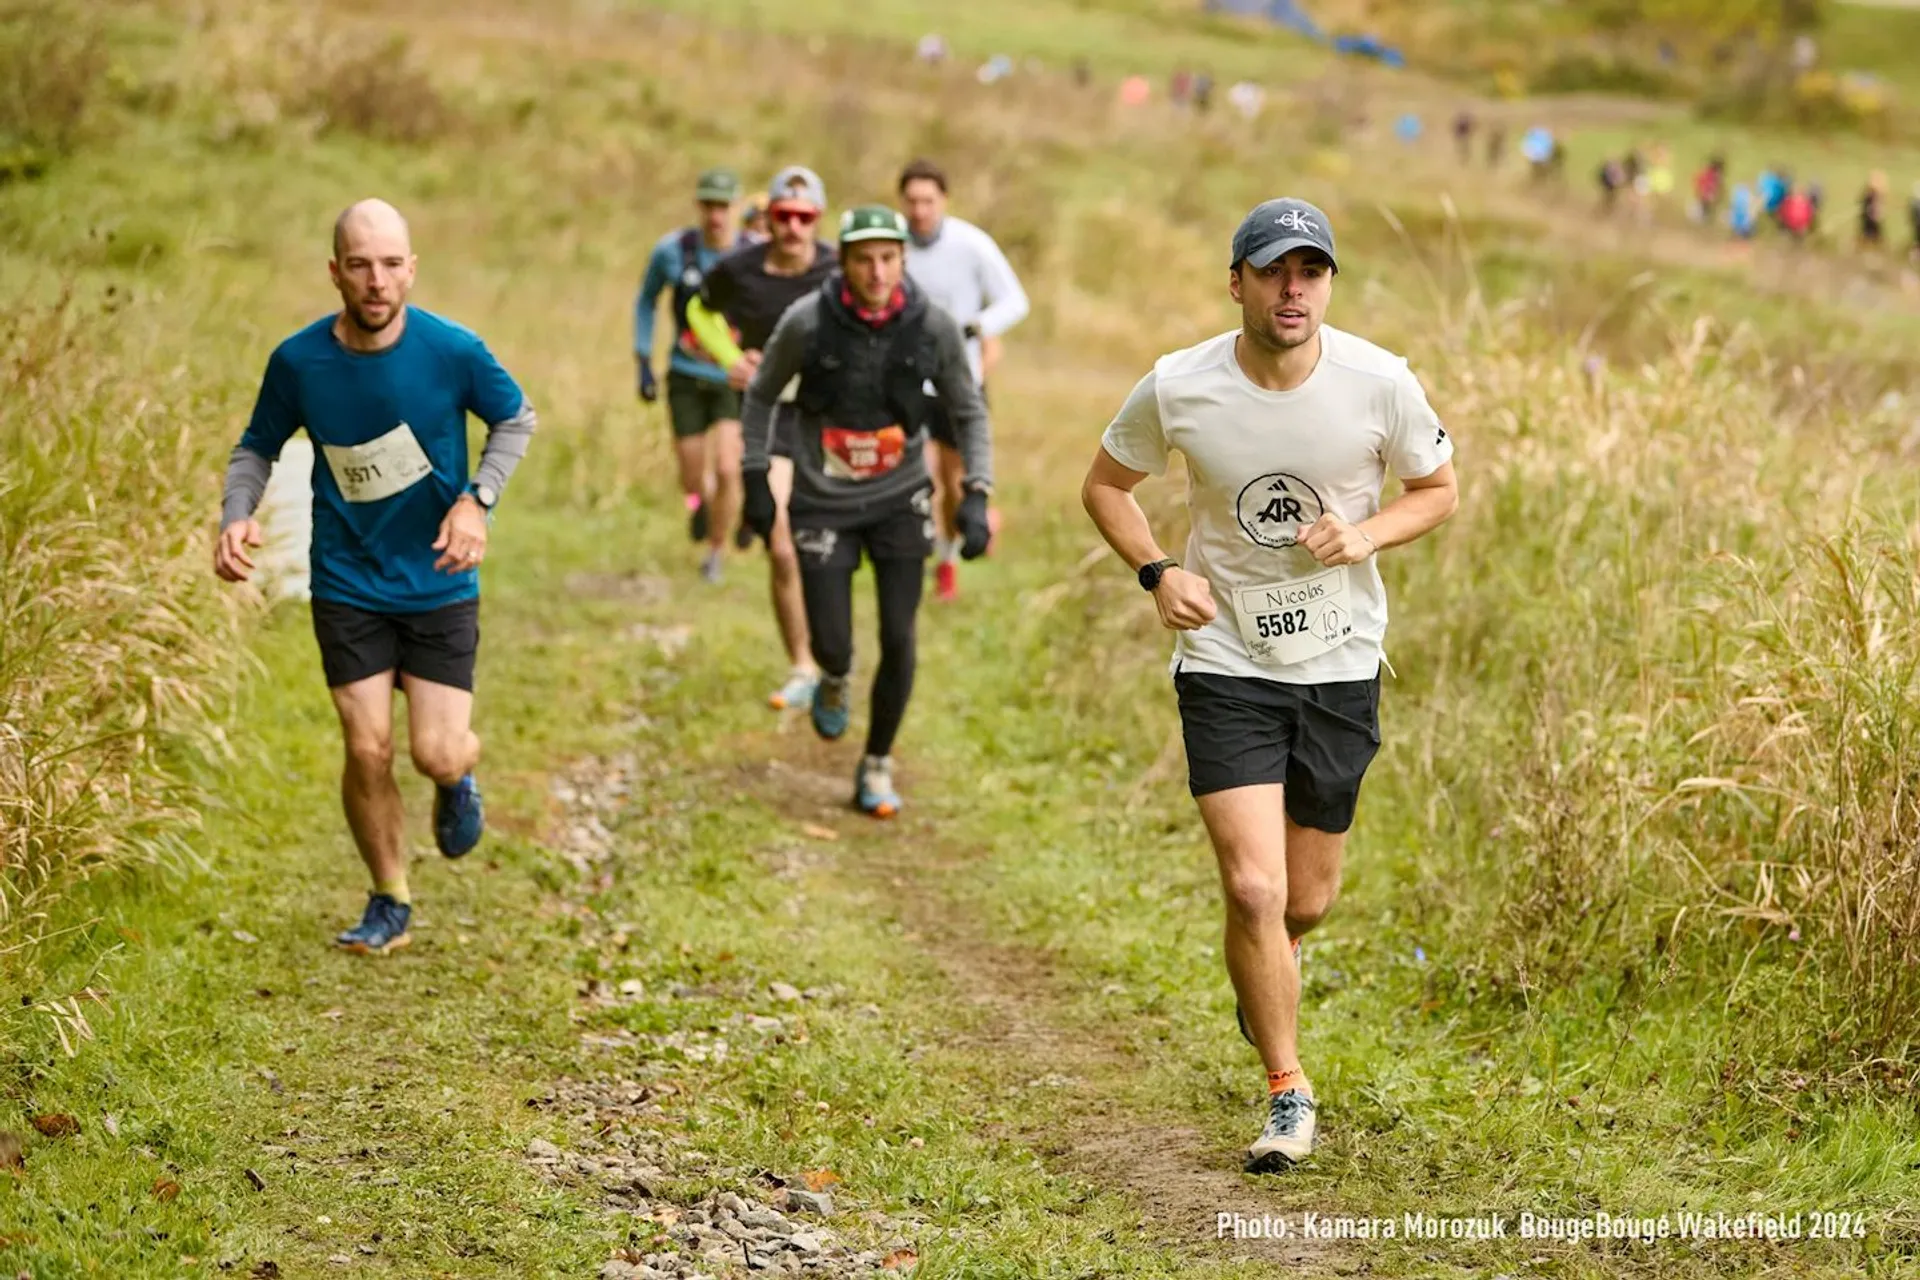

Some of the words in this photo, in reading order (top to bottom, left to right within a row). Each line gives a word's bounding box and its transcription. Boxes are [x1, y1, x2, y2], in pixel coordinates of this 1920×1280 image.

[343, 464, 382, 483] 5571
[1256, 498, 1303, 523] AR
[1266, 584, 1324, 608] Nicolas
[1256, 609, 1309, 638] 5582
[1322, 610, 1339, 632] 10
